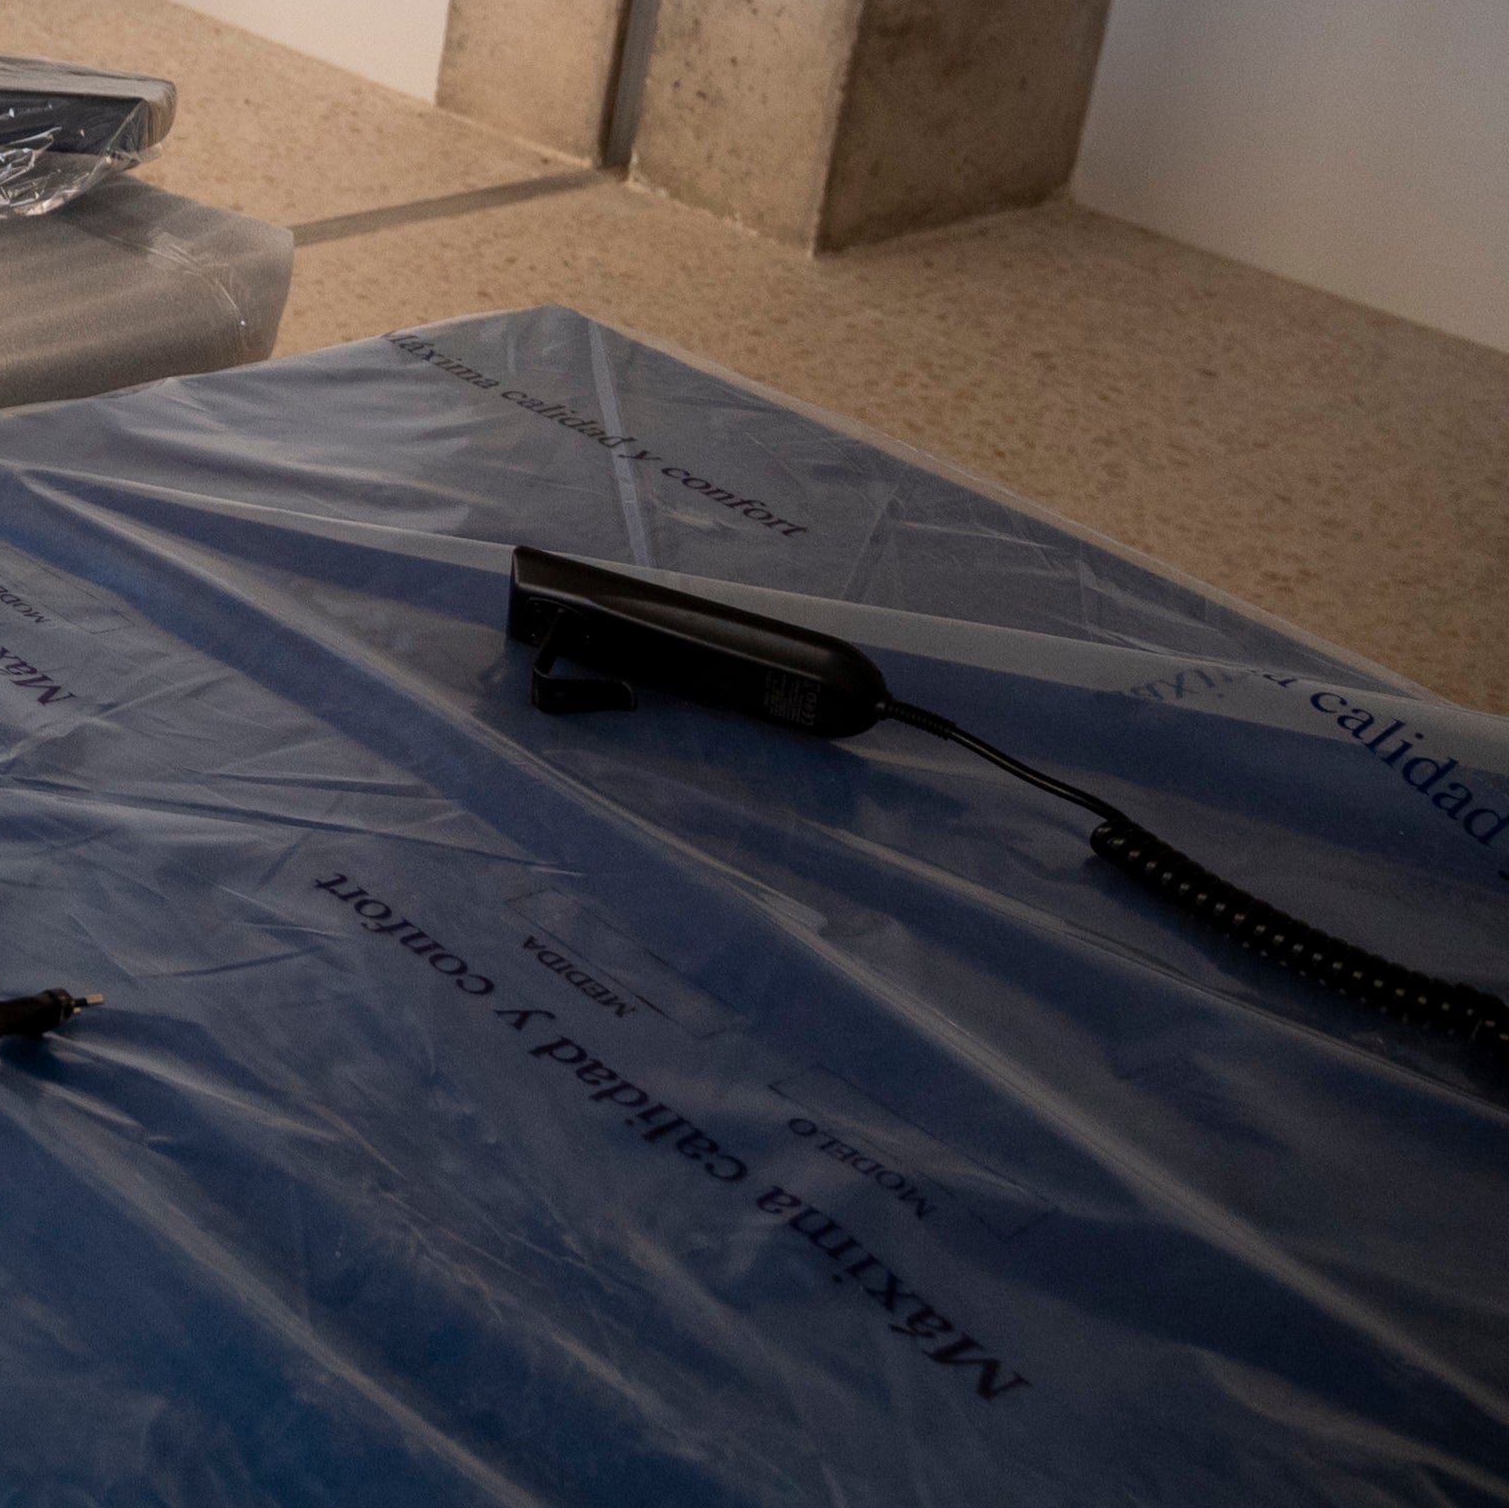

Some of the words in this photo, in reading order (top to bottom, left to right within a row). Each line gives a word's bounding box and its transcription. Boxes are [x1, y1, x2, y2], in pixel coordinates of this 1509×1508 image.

[501, 390, 637, 449] calidad
[618, 450, 662, 462] y
[661, 466, 809, 537] confort
[314, 872, 496, 996] confort
[521, 935, 636, 1018] MEDIDA
[494, 1009, 557, 1031] y
[528, 1036, 748, 1182] calidad
[788, 1118, 939, 1220] MODELO
[756, 1186, 1034, 1402] Máxima
